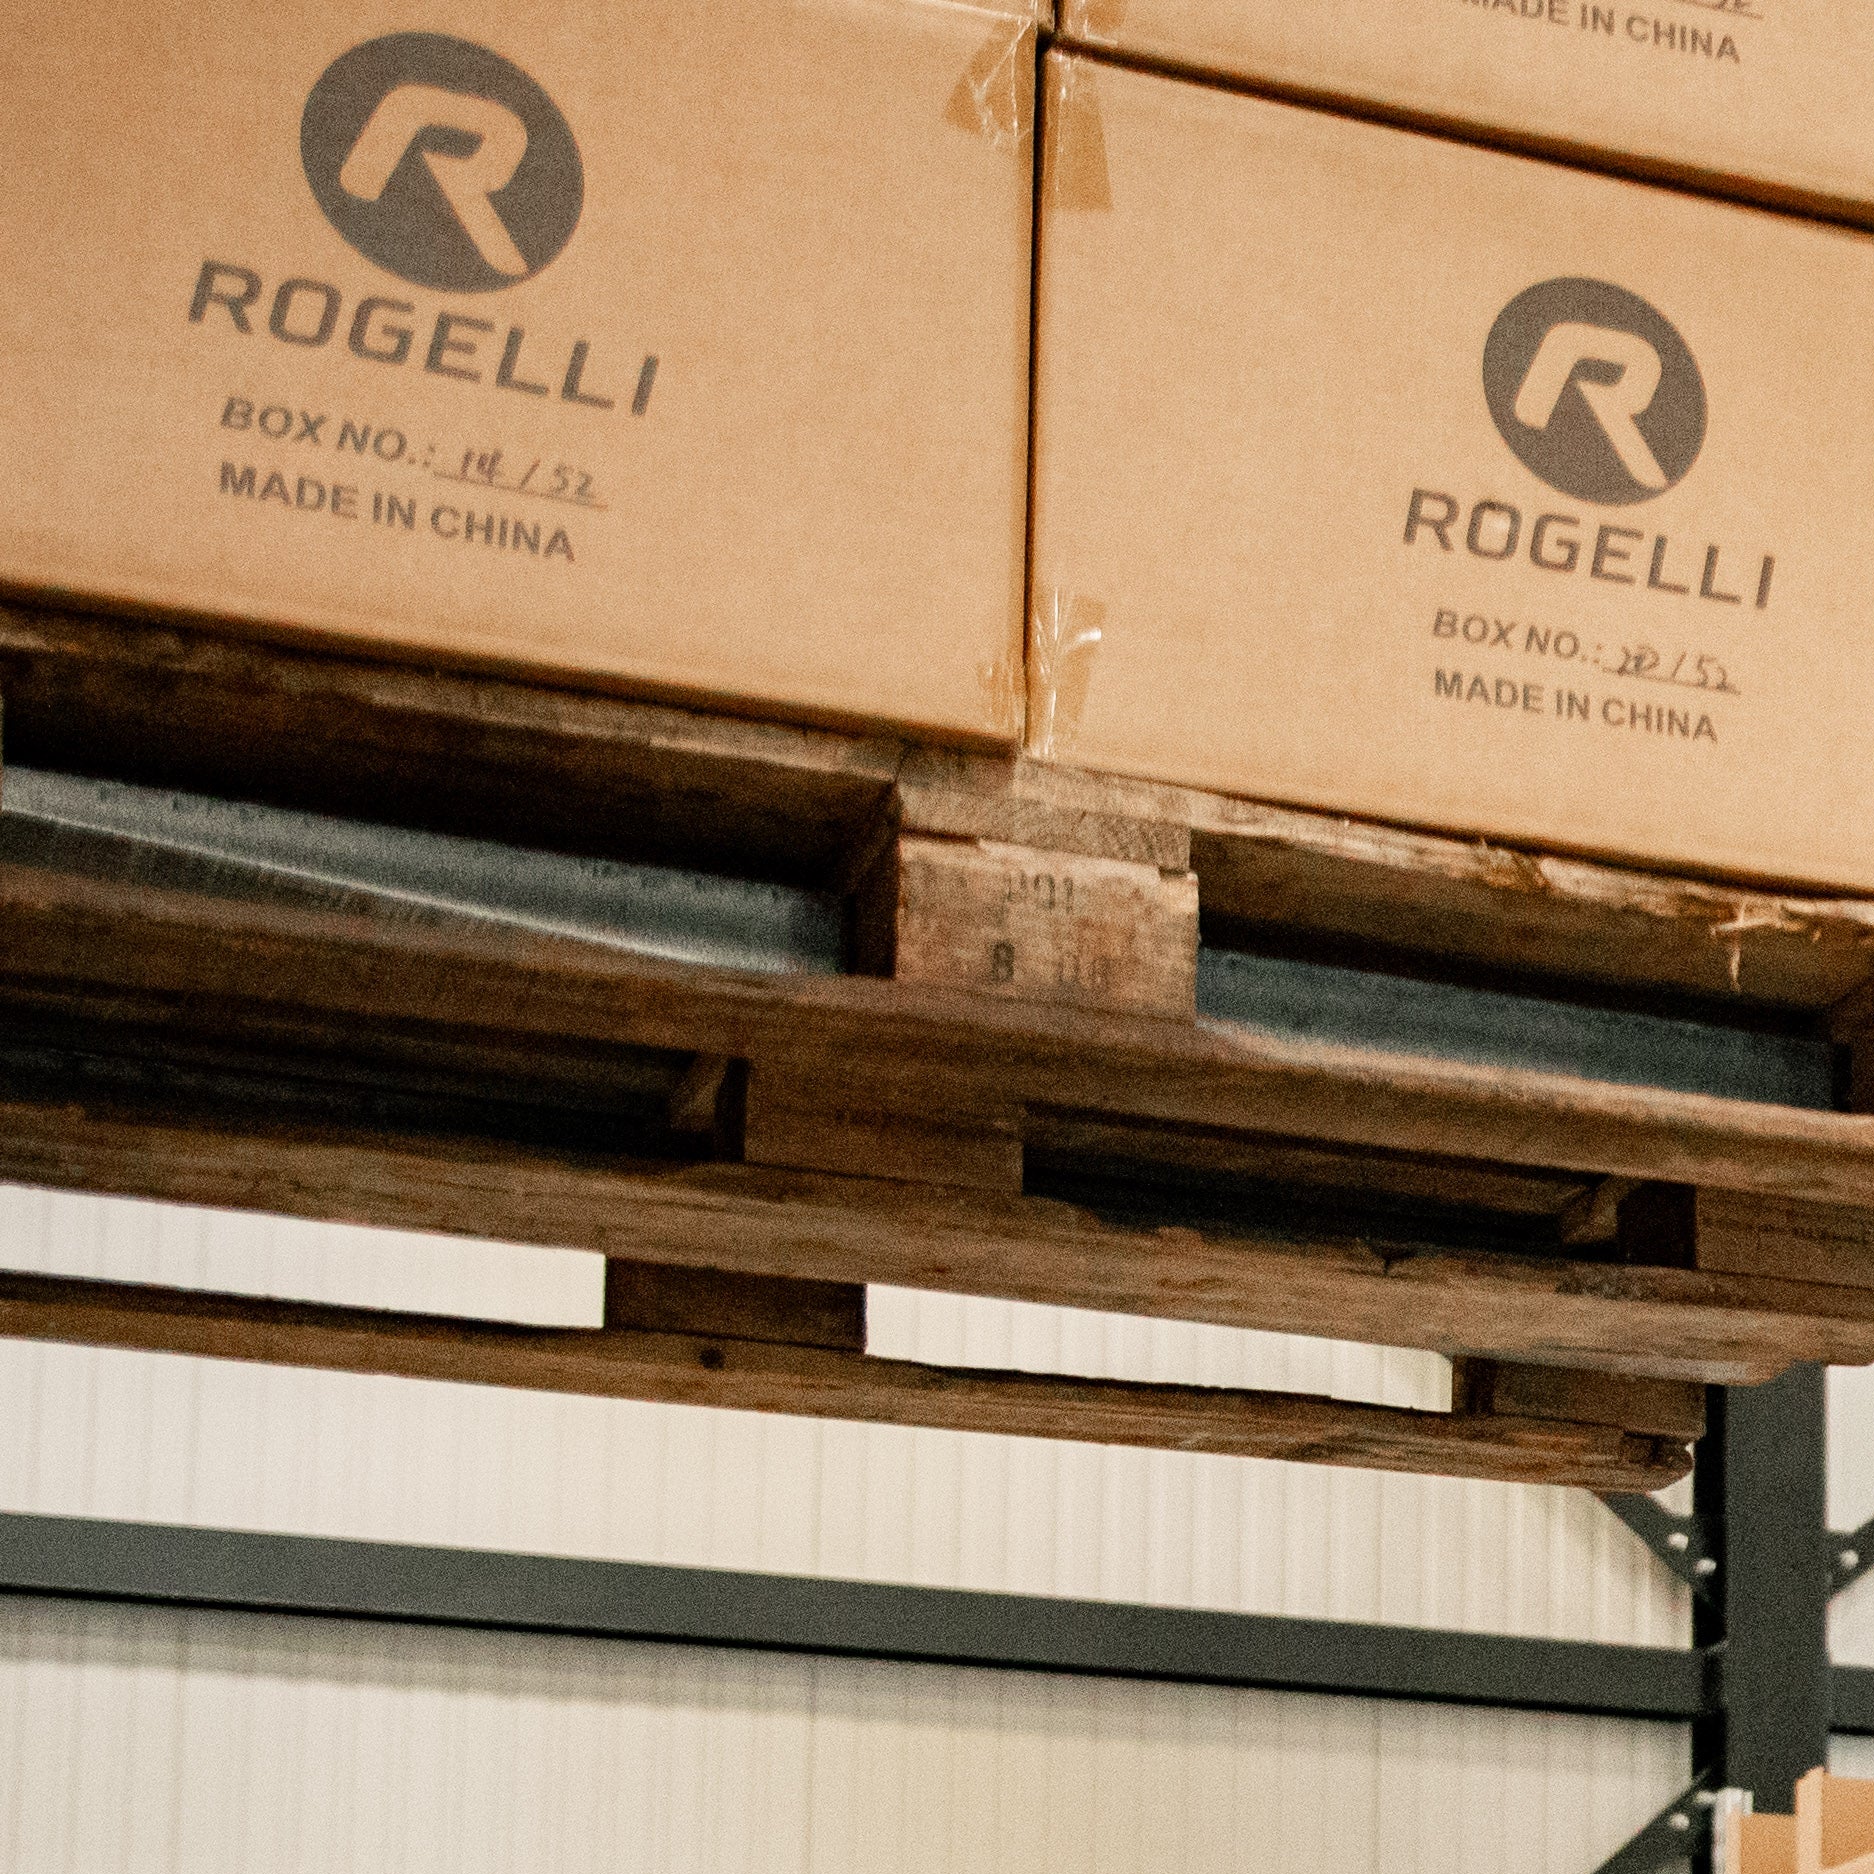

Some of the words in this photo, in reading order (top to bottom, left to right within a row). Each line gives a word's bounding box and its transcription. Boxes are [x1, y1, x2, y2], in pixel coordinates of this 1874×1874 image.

[1580, 4, 1615, 35] IN
[1625, 14, 1740, 64] CHINA
[188, 259, 659, 416] ROGELLI
[220, 396, 327, 445] BOX
[218, 460, 360, 521] MADE
[372, 491, 417, 532] IN
[430, 504, 576, 563] CHINA
[1402, 487, 1775, 611] ROGELLI
[1431, 607, 1519, 650] BOX
[1433, 666, 1546, 716] MADE
[1555, 688, 1591, 722] IN
[1602, 697, 1719, 744] CHINA
